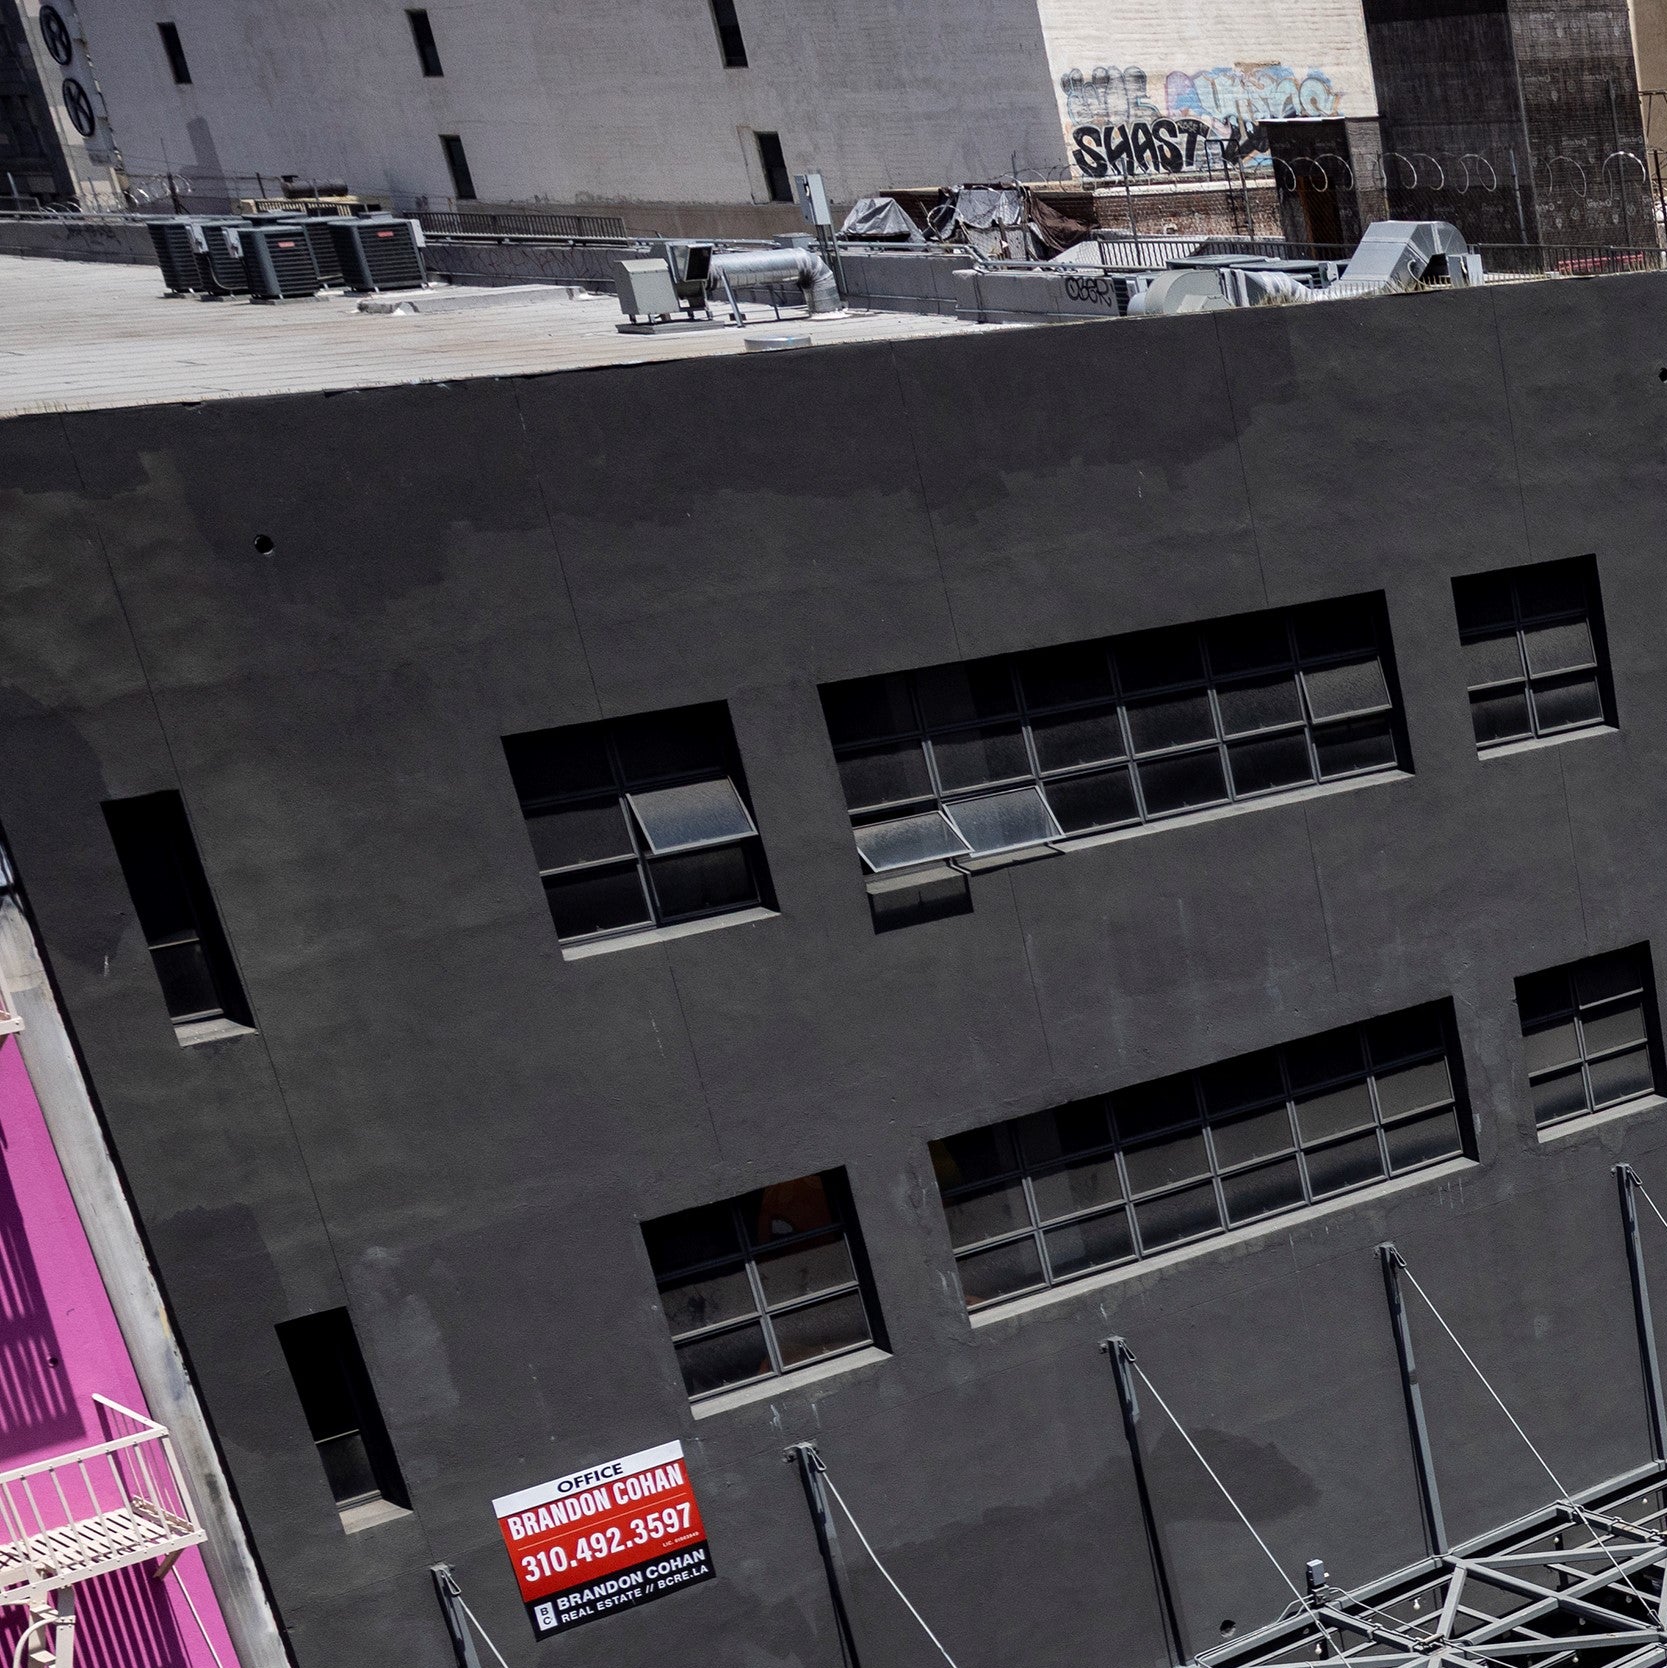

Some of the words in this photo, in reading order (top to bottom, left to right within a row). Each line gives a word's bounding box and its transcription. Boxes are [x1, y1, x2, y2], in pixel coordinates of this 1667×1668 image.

[507, 1487, 612, 1541] BRANDON
[613, 1463, 684, 1506] COHAN
[558, 1462, 623, 1493] OFFICE
[521, 1502, 692, 1582] 310.492.3597
[557, 1571, 643, 1611] BRANDON
[646, 1548, 705, 1580] COHAN
[561, 1604, 594, 1623] REAL
[597, 1588, 643, 1612] ESTATE
[657, 1565, 709, 1591] BCRE.LA
